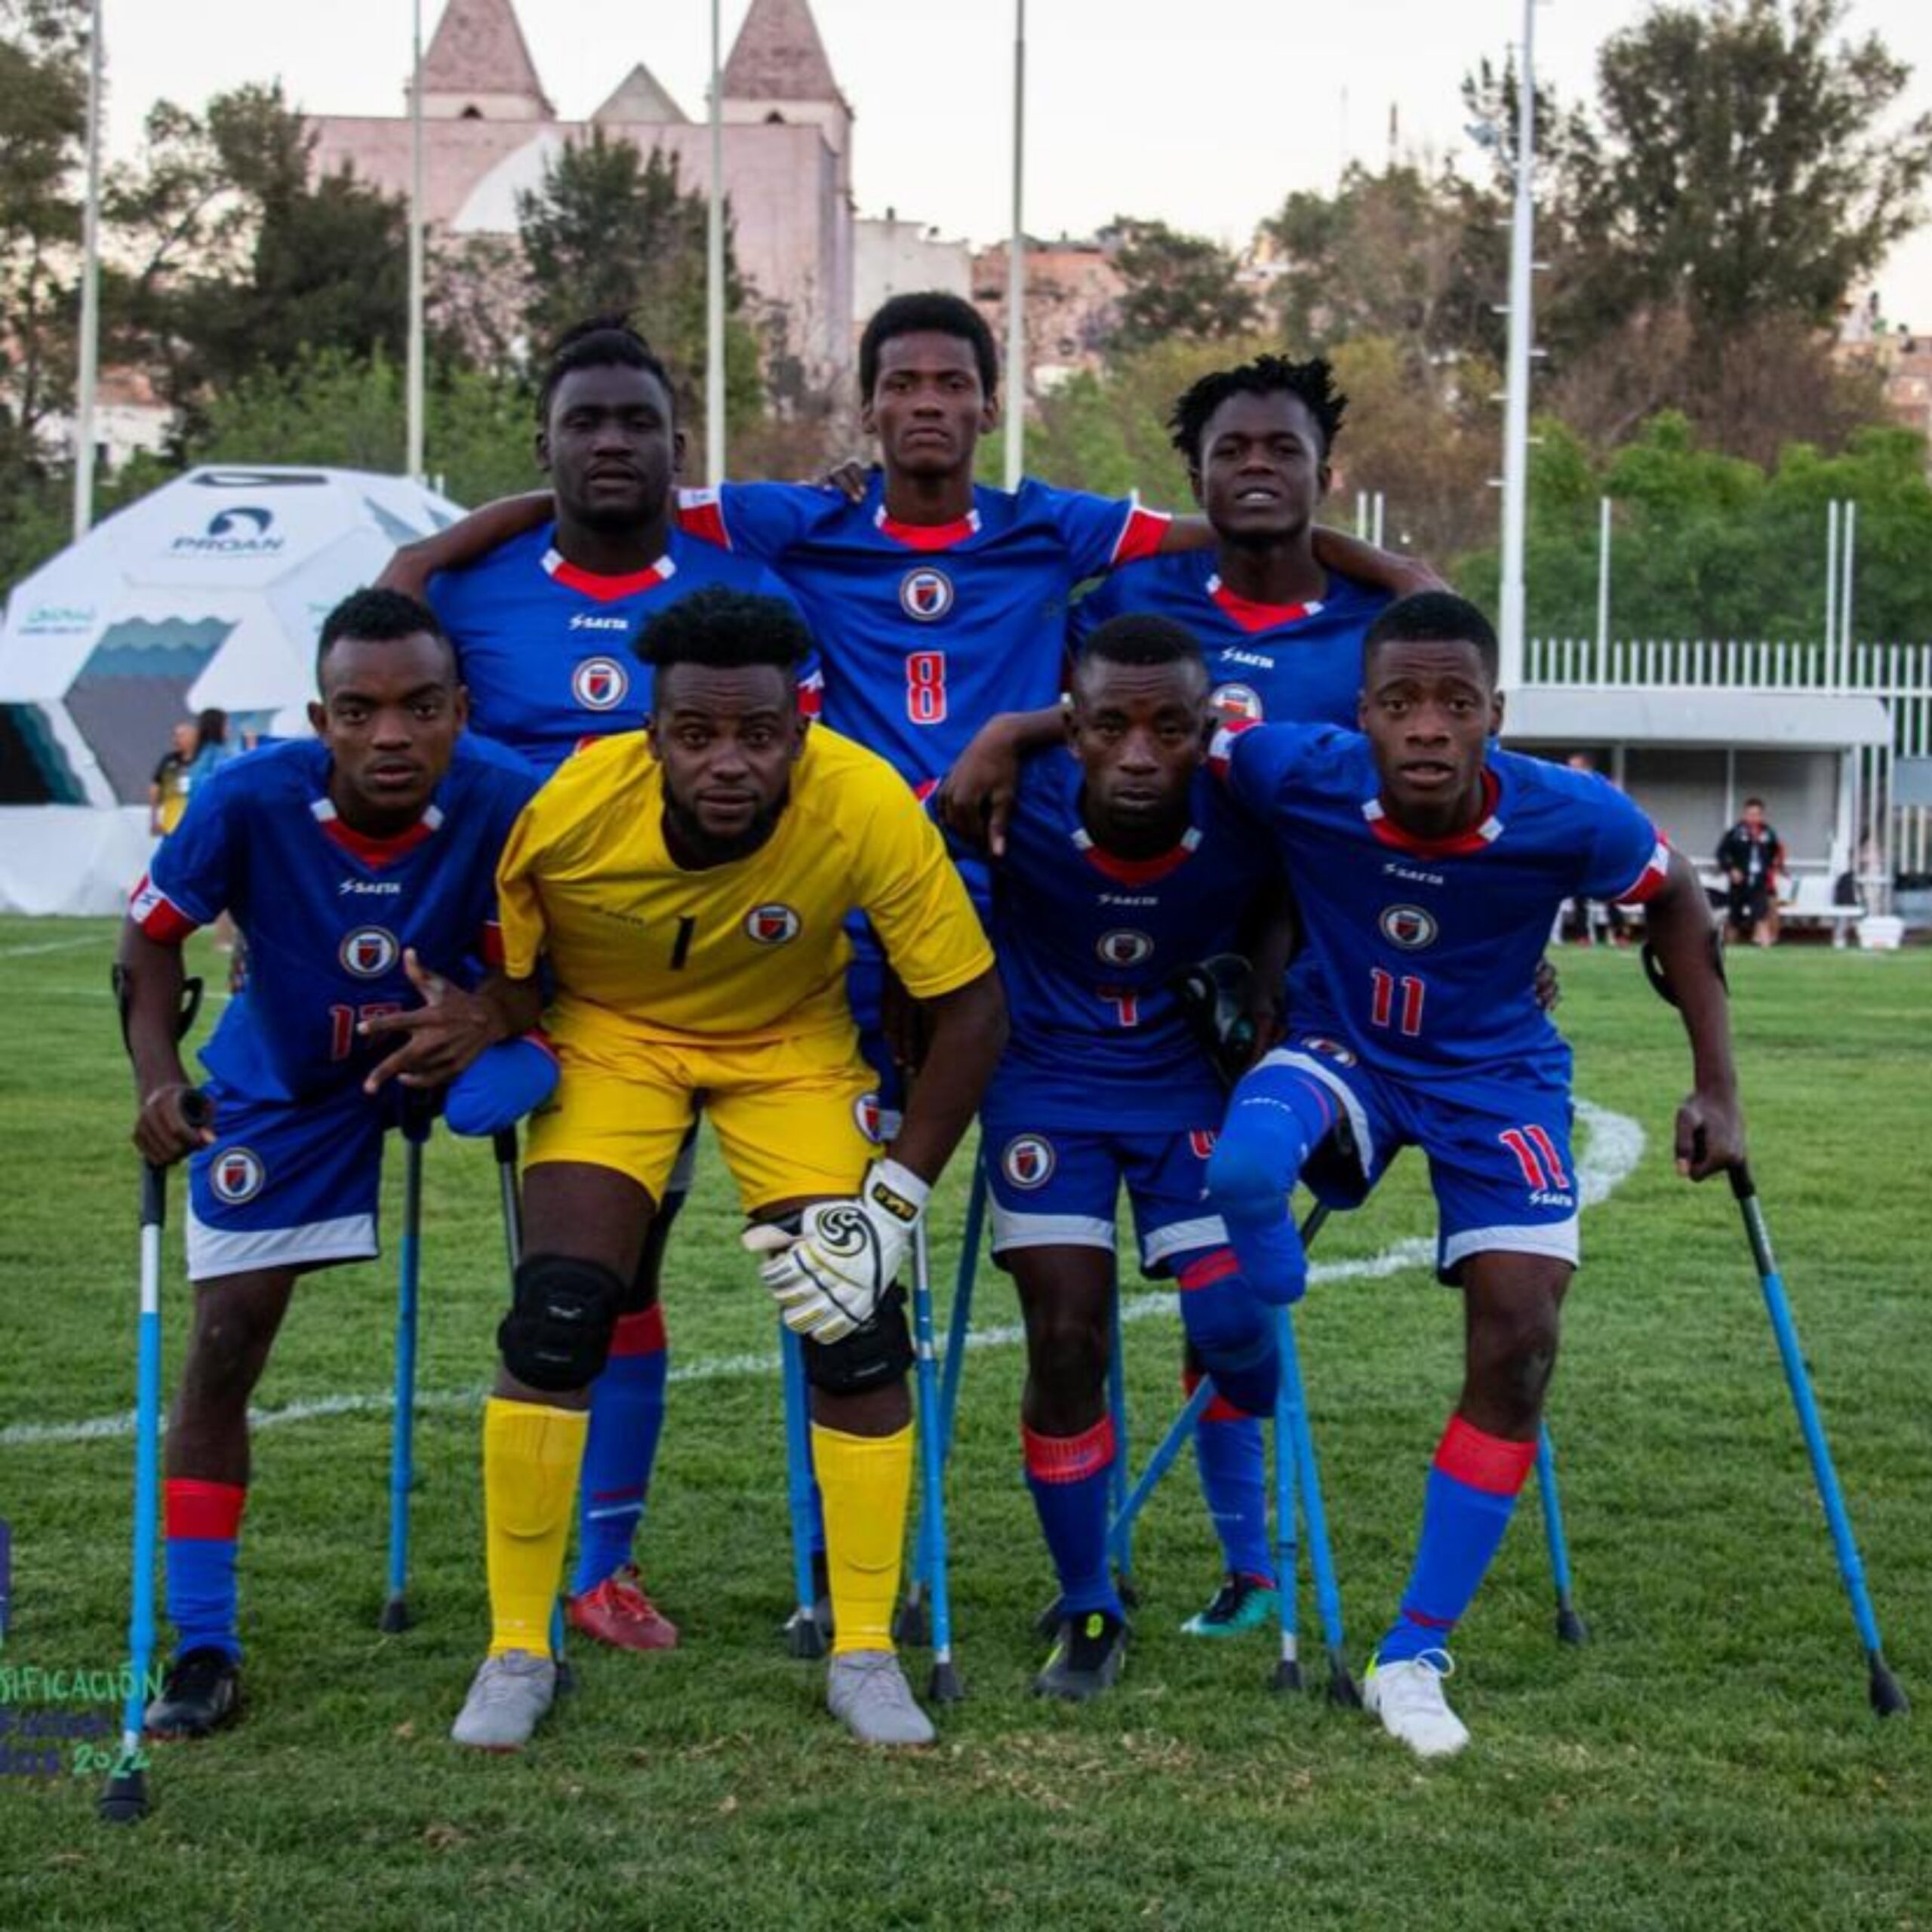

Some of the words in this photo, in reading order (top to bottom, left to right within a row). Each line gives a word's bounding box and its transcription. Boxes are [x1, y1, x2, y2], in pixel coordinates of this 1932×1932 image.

[906, 650, 946, 725] 8
[669, 915, 696, 971] 1
[1370, 967, 1426, 1037] 11
[1498, 1124, 1569, 1190] 11
